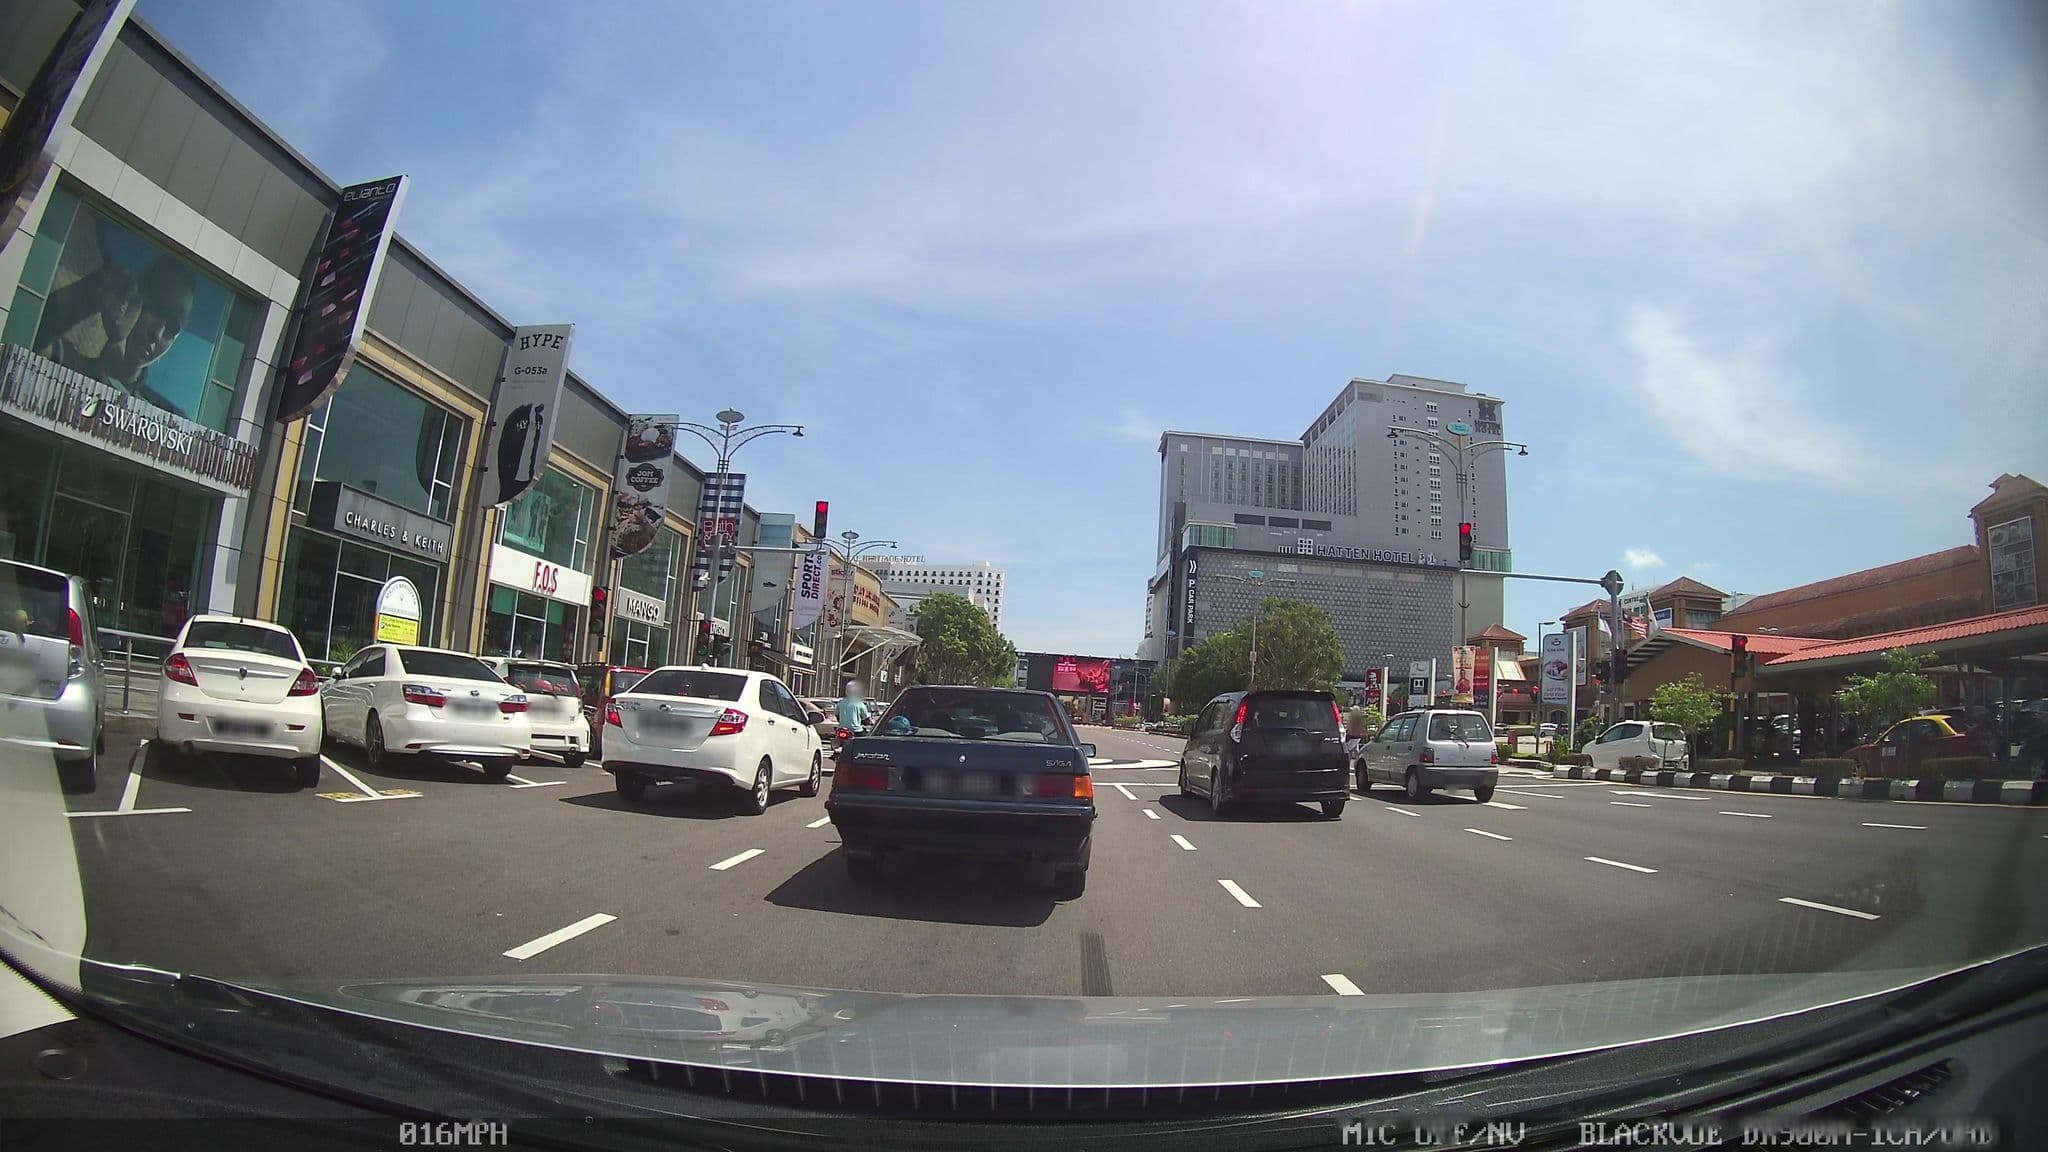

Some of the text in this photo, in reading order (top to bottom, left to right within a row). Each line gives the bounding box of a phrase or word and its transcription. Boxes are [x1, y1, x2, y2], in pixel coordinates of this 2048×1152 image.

[520, 334, 563, 350] HYPE
[103, 404, 194, 456] SWAROVSKI
[345, 511, 443, 553] CHARLES & KEITH
[1316, 544, 1370, 560] HATTEN
[1373, 550, 1416, 564] HOTEL
[1188, 579, 1196, 588] P
[626, 597, 660, 622] MANGO
[1186, 605, 1194, 624] PARK
[1045, 759, 1073, 768] SAGA
